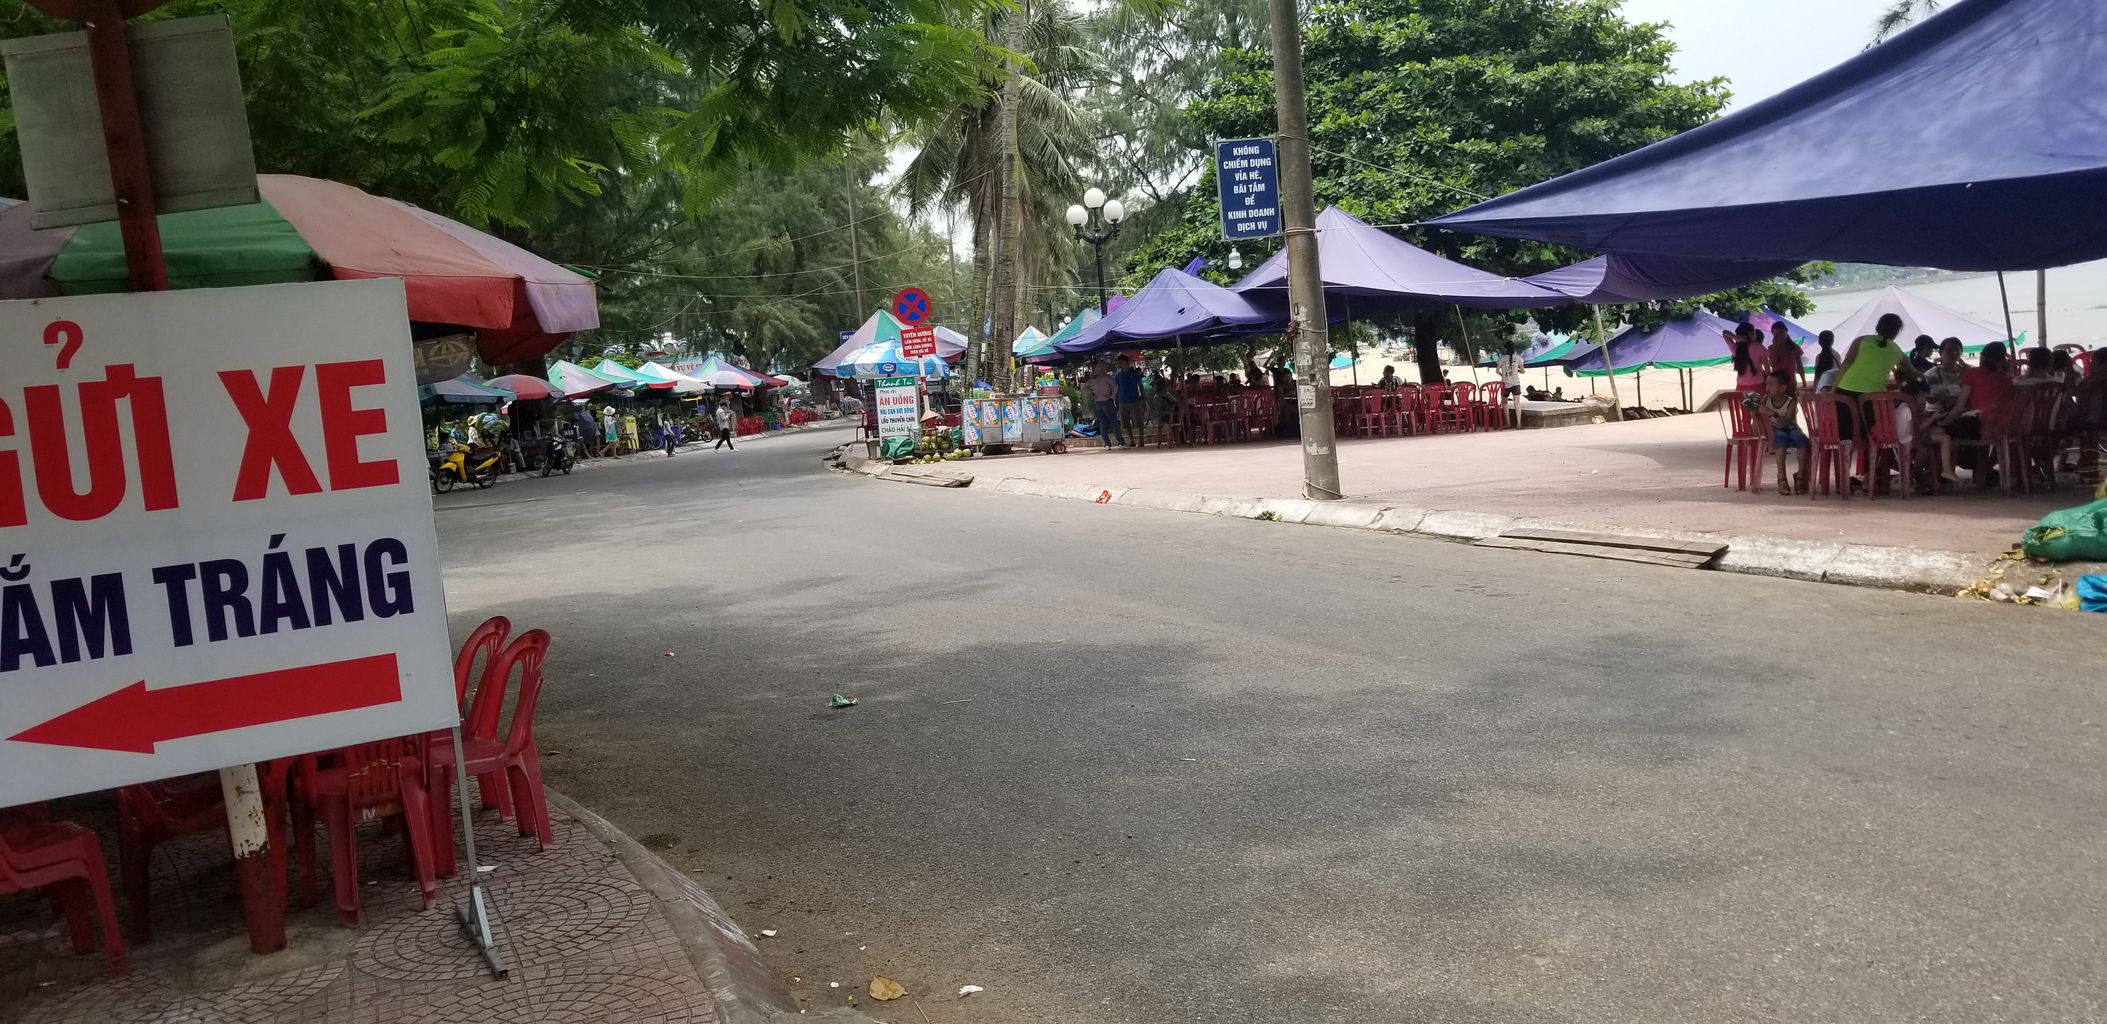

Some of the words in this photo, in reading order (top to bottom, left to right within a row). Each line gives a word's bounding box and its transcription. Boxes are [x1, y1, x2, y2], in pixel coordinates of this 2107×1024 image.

[1233, 145, 1260, 156] KHÔNG
[1223, 157, 1248, 169] CHIẾM
[1250, 158, 1271, 169] DỤNG
[1233, 184, 1247, 194] BÃI
[1228, 211, 1247, 220] KINH
[1248, 208, 1275, 218] DOANH
[1237, 222, 1255, 232] DỊCH
[1257, 221, 1268, 231] VỤ
[877, 379, 900, 387] Thanh
[880, 396, 890, 406] ĂN
[893, 393, 914, 405] UỐNG
[0, 320, 179, 528] ỬI
[217, 359, 400, 502] XE
[152, 533, 414, 648] TRÁNG
